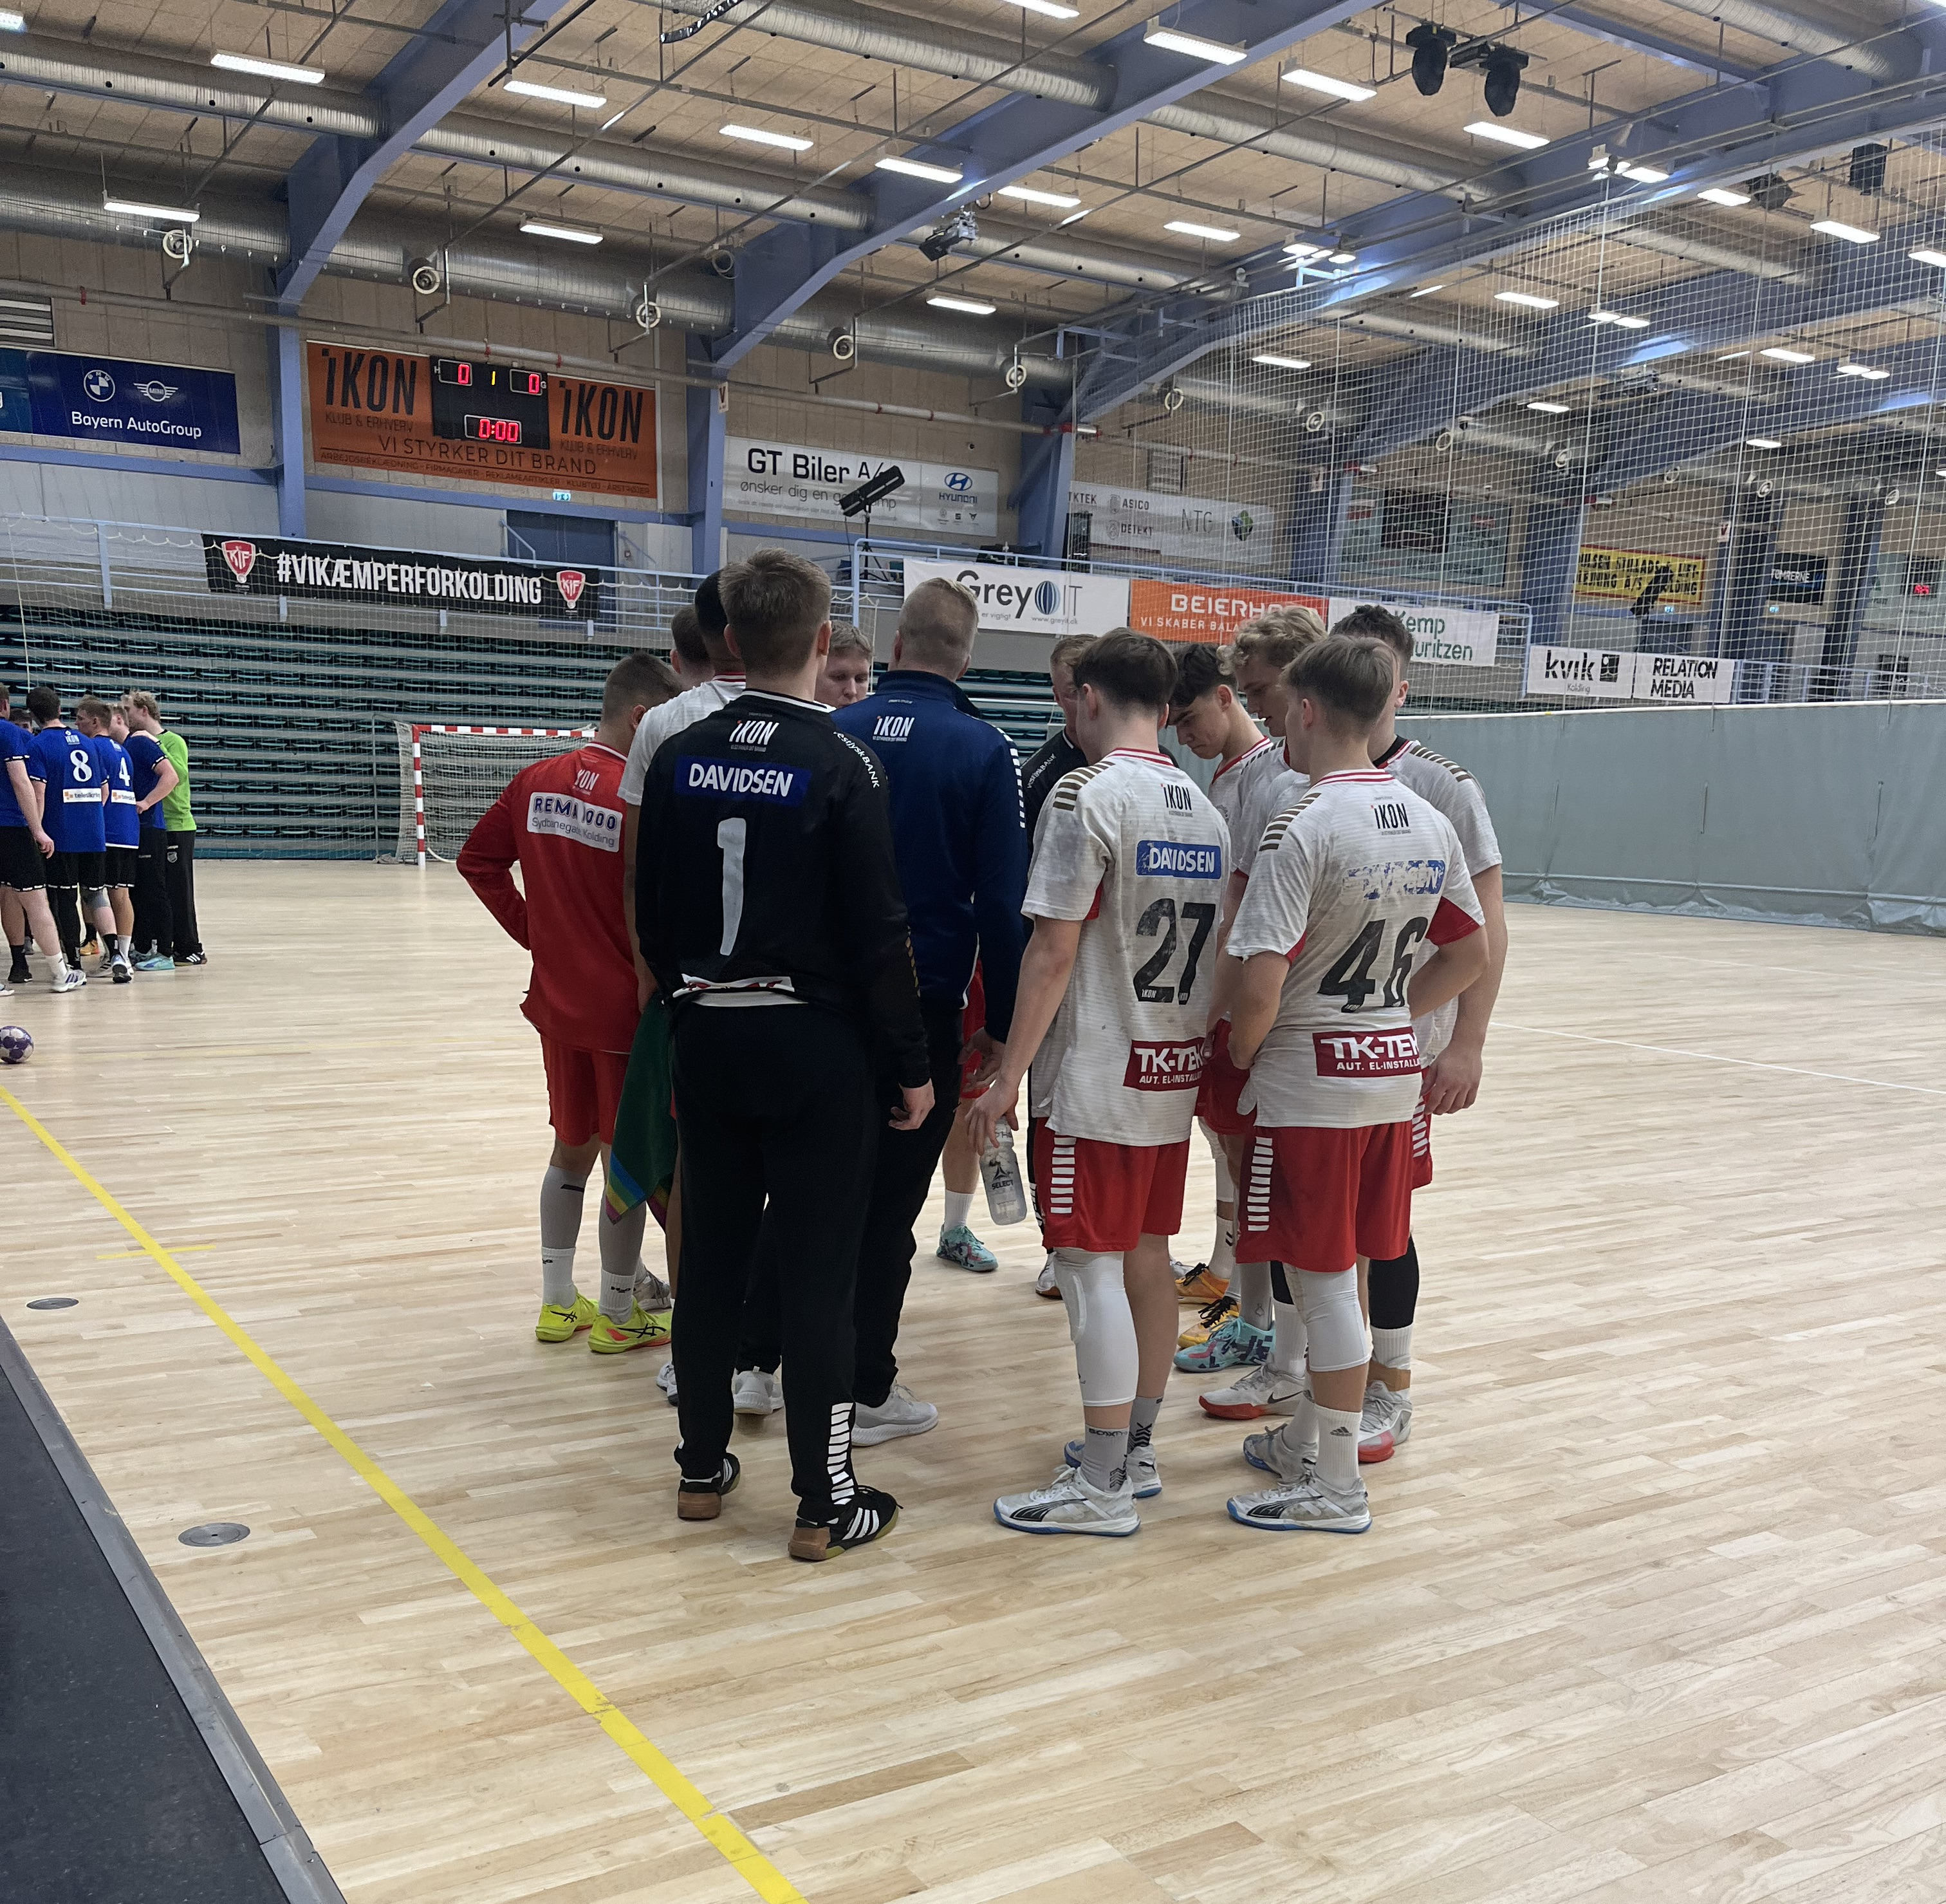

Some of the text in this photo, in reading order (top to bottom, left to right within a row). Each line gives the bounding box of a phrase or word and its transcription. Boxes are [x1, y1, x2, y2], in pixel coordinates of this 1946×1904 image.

[458, 363, 470, 384] 0
[492, 371, 496, 385] 1
[528, 373, 540, 393] 0
[71, 411, 202, 440] Bayern AutoGroup
[326, 411, 352, 425] KLUB
[479, 418, 519, 442] 0:00
[378, 434, 597, 475] VI STYRKER DIT BRAND
[747, 447, 885, 484] GT Biler A/
[740, 480, 783, 496] ønsker
[788, 483, 808, 502] dig
[812, 489, 828, 501] en
[939, 492, 978, 504] HYUNDAI
[1122, 498, 1149, 510] ASICO
[1121, 523, 1154, 536] DETEKT
[1181, 509, 1213, 534] NTG
[226, 550, 250, 570] KIF
[1579, 553, 1611, 570] ULSEN
[277, 553, 542, 604] #VIKÆMPERFORKOLDING
[562, 578, 580, 597] KIF
[1577, 570, 1617, 588] LEJNING
[1062, 584, 1083, 617] IT
[1140, 617, 1152, 627] VI
[1157, 618, 1205, 630] SKABER
[1414, 639, 1473, 661] uritzen
[1545, 649, 1595, 681] kvik
[1653, 657, 1718, 679] RELATION
[1650, 679, 1695, 699] MEDIA
[70, 749, 93, 782] 8
[833, 731, 880, 789] estjyskBANK
[119, 756, 131, 787] 4
[688, 763, 793, 797] DAVIDSEN
[1149, 846, 1215, 873] DAVIDSEN
[717, 817, 746, 956] 1
[1133, 898, 1216, 1005] 27
[1317, 915, 1429, 1013] 46
[1336, 1061, 1365, 1071] AUT.
[1139, 1076, 1160, 1085] AUT.
[991, 1179, 1014, 1190] SELECT
